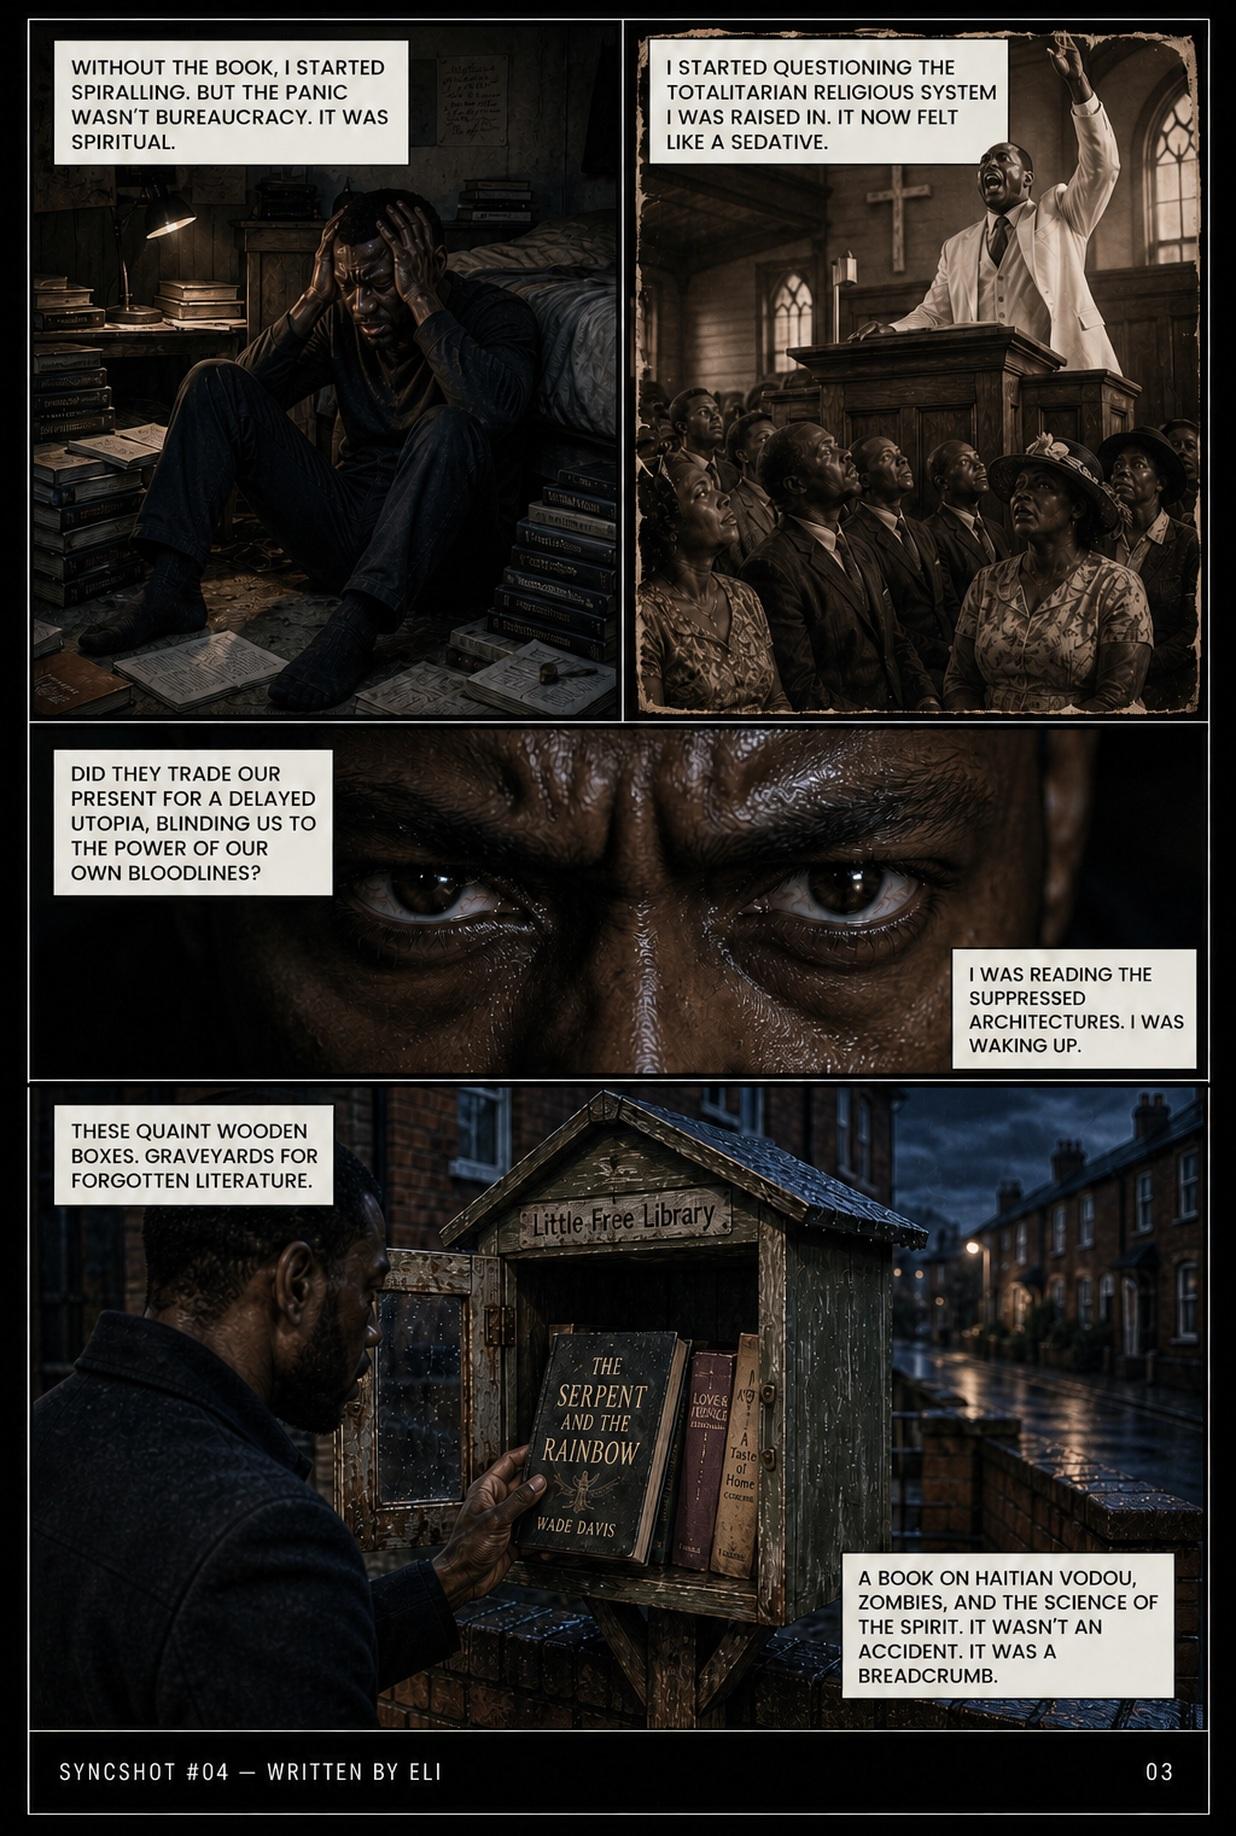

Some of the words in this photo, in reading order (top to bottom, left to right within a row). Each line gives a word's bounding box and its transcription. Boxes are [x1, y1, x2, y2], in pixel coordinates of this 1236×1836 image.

[533, 1210, 584, 1237] Little
[592, 1207, 634, 1232] Free
[643, 1202, 716, 1232] Library
[592, 1356, 623, 1376] THE
[556, 1383, 648, 1409] SERPENT
[560, 1413, 594, 1431] AND
[600, 1414, 631, 1433] THE
[740, 1432, 748, 1447] A
[541, 1437, 640, 1465] RAINBOW
[730, 1446, 757, 1462] Taste
[736, 1463, 747, 1475] of
[726, 1473, 756, 1490] Home
[537, 1516, 572, 1534] WADE
[577, 1520, 617, 1538] DAVIS
